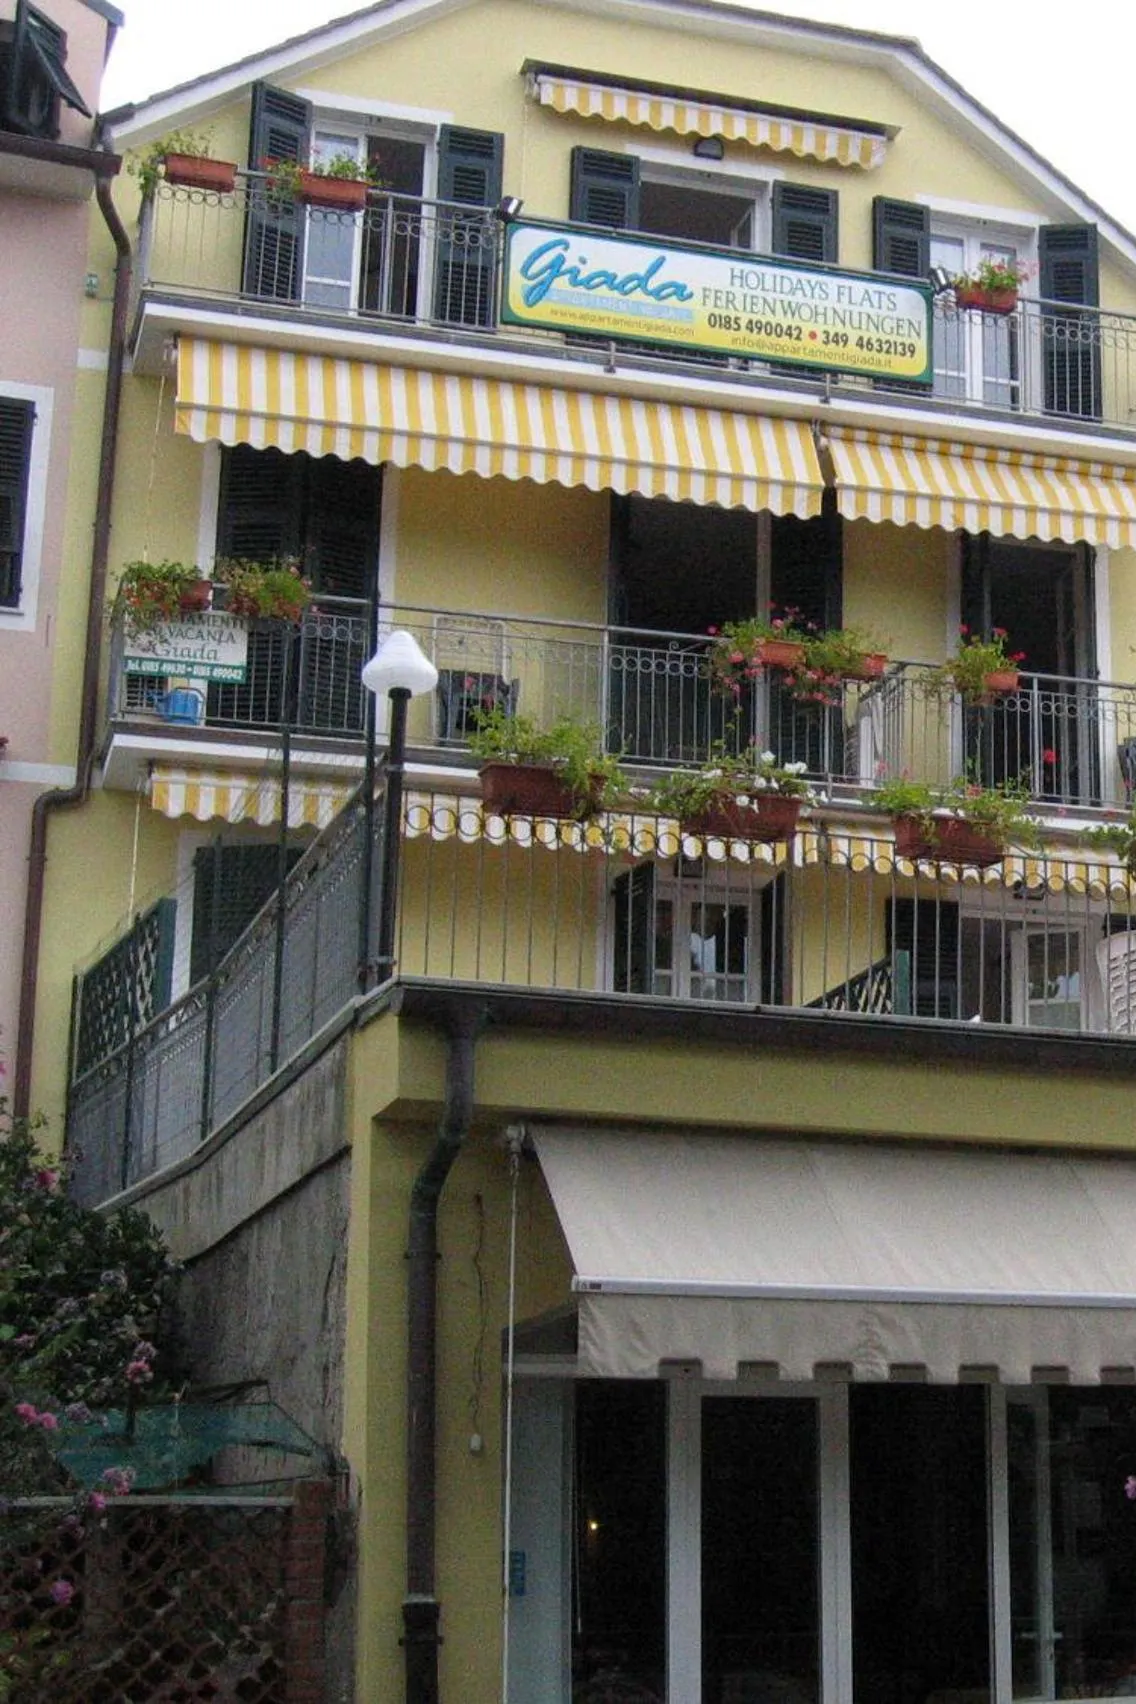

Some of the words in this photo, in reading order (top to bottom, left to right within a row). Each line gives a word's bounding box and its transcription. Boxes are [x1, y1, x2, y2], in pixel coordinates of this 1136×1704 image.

[520, 238, 694, 308] Giada
[729, 267, 830, 301] HOLIDAYS
[836, 284, 898, 312] FLATS
[701, 287, 922, 340] FERIENWOHNUNGEN
[707, 312, 741, 332] 0185
[745, 318, 803, 342] 490042
[822, 330, 849, 349] 349
[855, 335, 917, 359] 4632139
